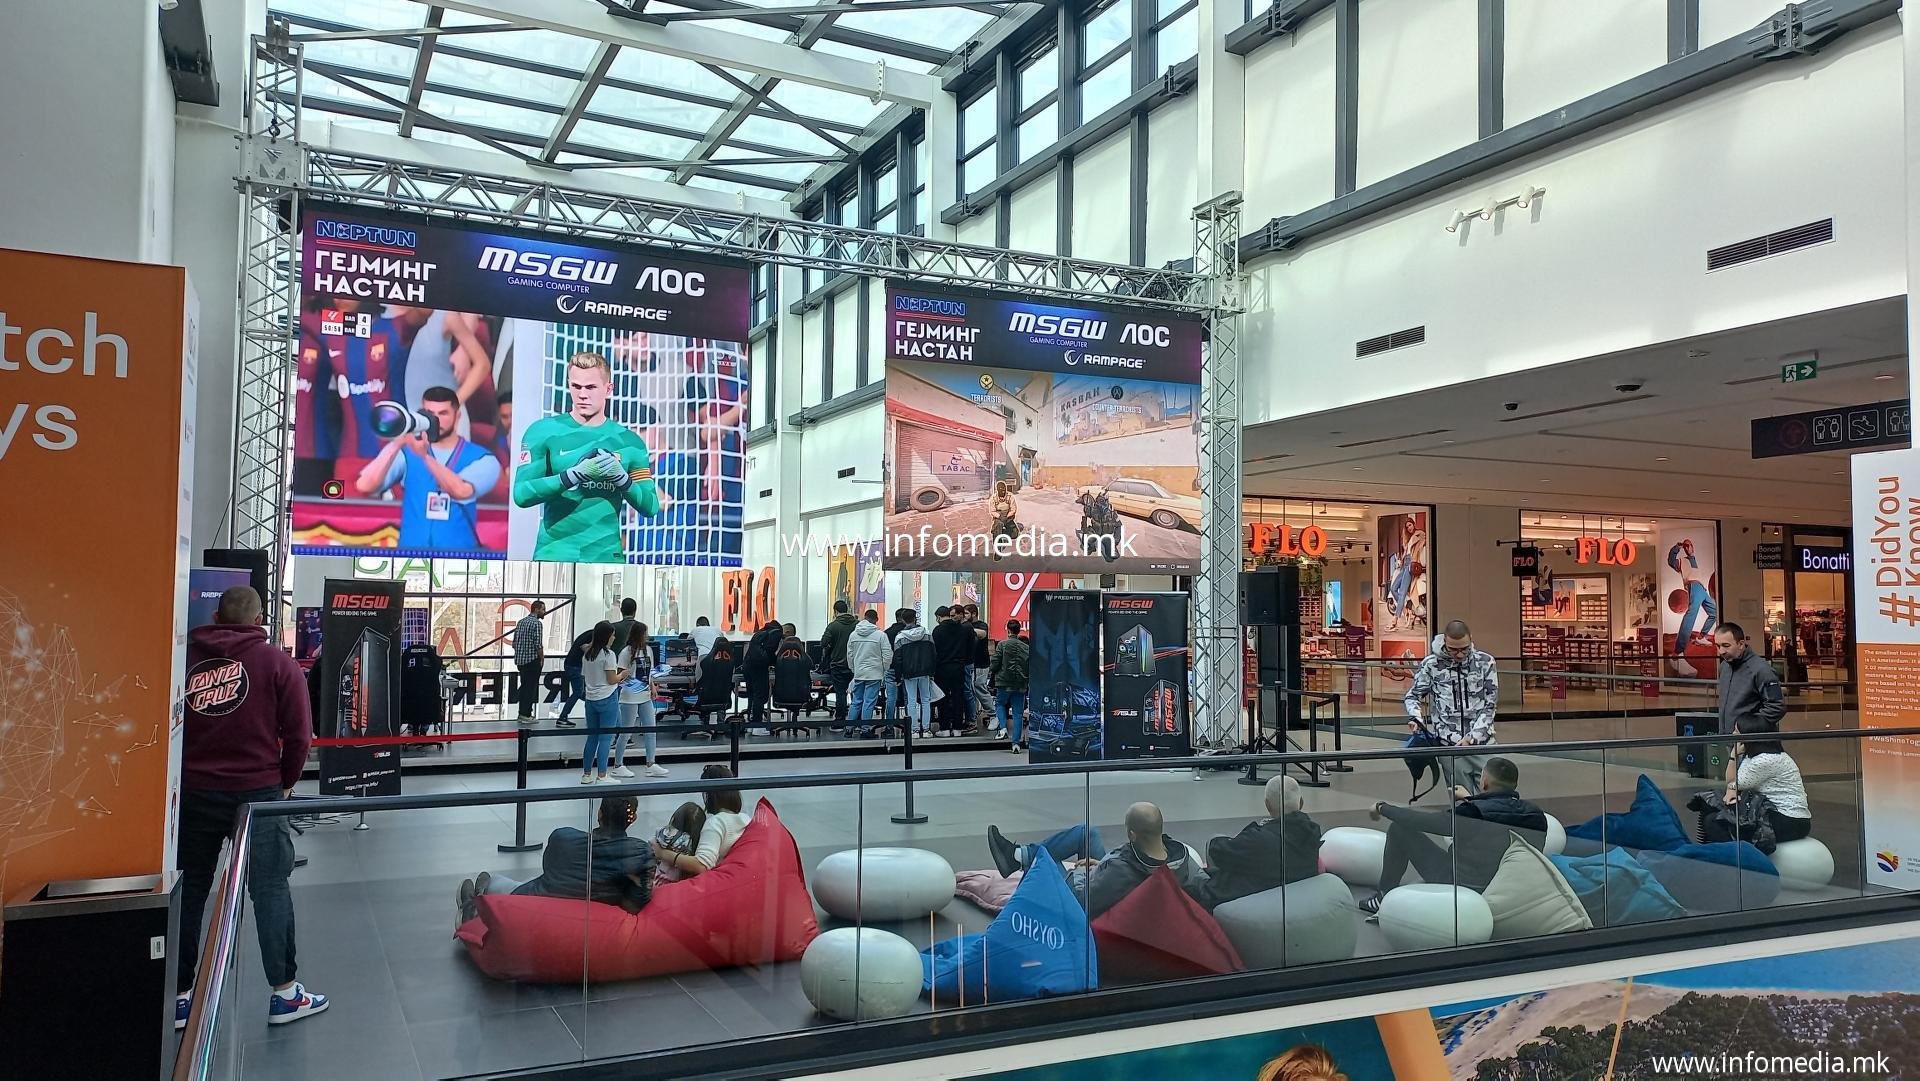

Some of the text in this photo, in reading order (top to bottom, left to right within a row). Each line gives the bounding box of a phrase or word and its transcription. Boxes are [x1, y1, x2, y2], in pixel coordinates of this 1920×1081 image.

[316, 220, 416, 248] NEPTUN
[315, 249, 437, 281] ГЕЈМИНГ
[478, 246, 618, 285] MSGW
[314, 272, 425, 303] НАСТАН
[507, 276, 590, 294] GAMING COMPUTER
[584, 301, 671, 321] RAMPAGE
[895, 295, 966, 316] NEPTUN
[895, 320, 981, 343] ГЕЈМИНГ
[1008, 312, 1108, 340] MSGW
[895, 339, 973, 361] НАСТАН
[1029, 336, 1088, 348] GAMING COMPUTER
[1083, 354, 1143, 369] RAMPAGE
[940, 464, 970, 472] TABAC
[1248, 522, 1329, 556] FLO
[1758, 545, 1782, 553] Bonatti
[1513, 556, 1535, 567] FLO
[1575, 537, 1637, 566] FLO
[1803, 547, 1850, 570] Bonatti
[332, 594, 390, 609] MSGW
[720, 566, 776, 634] FLO
[1107, 600, 1154, 609] MSGW
[185, 662, 243, 697] SANTA
[193, 680, 242, 711] CRUZ
